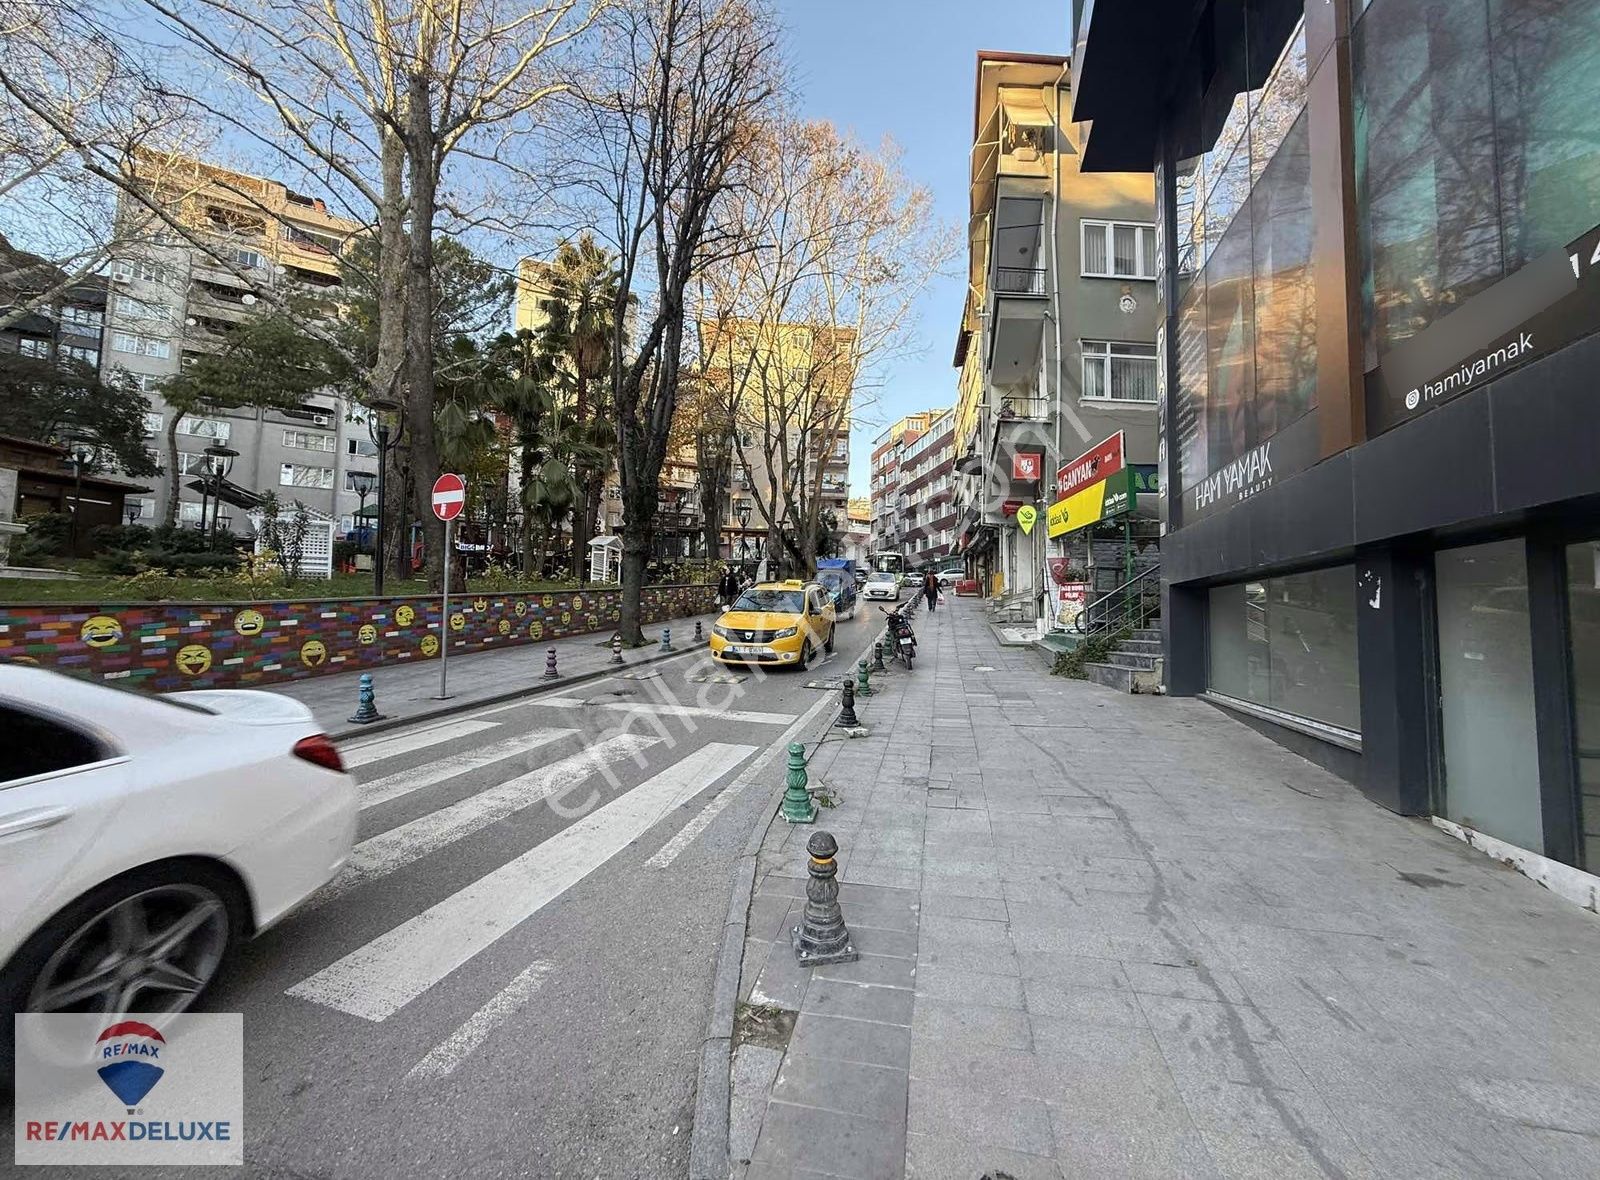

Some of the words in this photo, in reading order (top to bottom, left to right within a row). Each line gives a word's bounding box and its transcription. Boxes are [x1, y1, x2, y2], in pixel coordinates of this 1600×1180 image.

[1423, 332, 1534, 401] hamiyamak
[1063, 460, 1092, 491] GANYAN
[1223, 442, 1272, 495] YAMAK
[1239, 477, 1273, 501] BEAUTY
